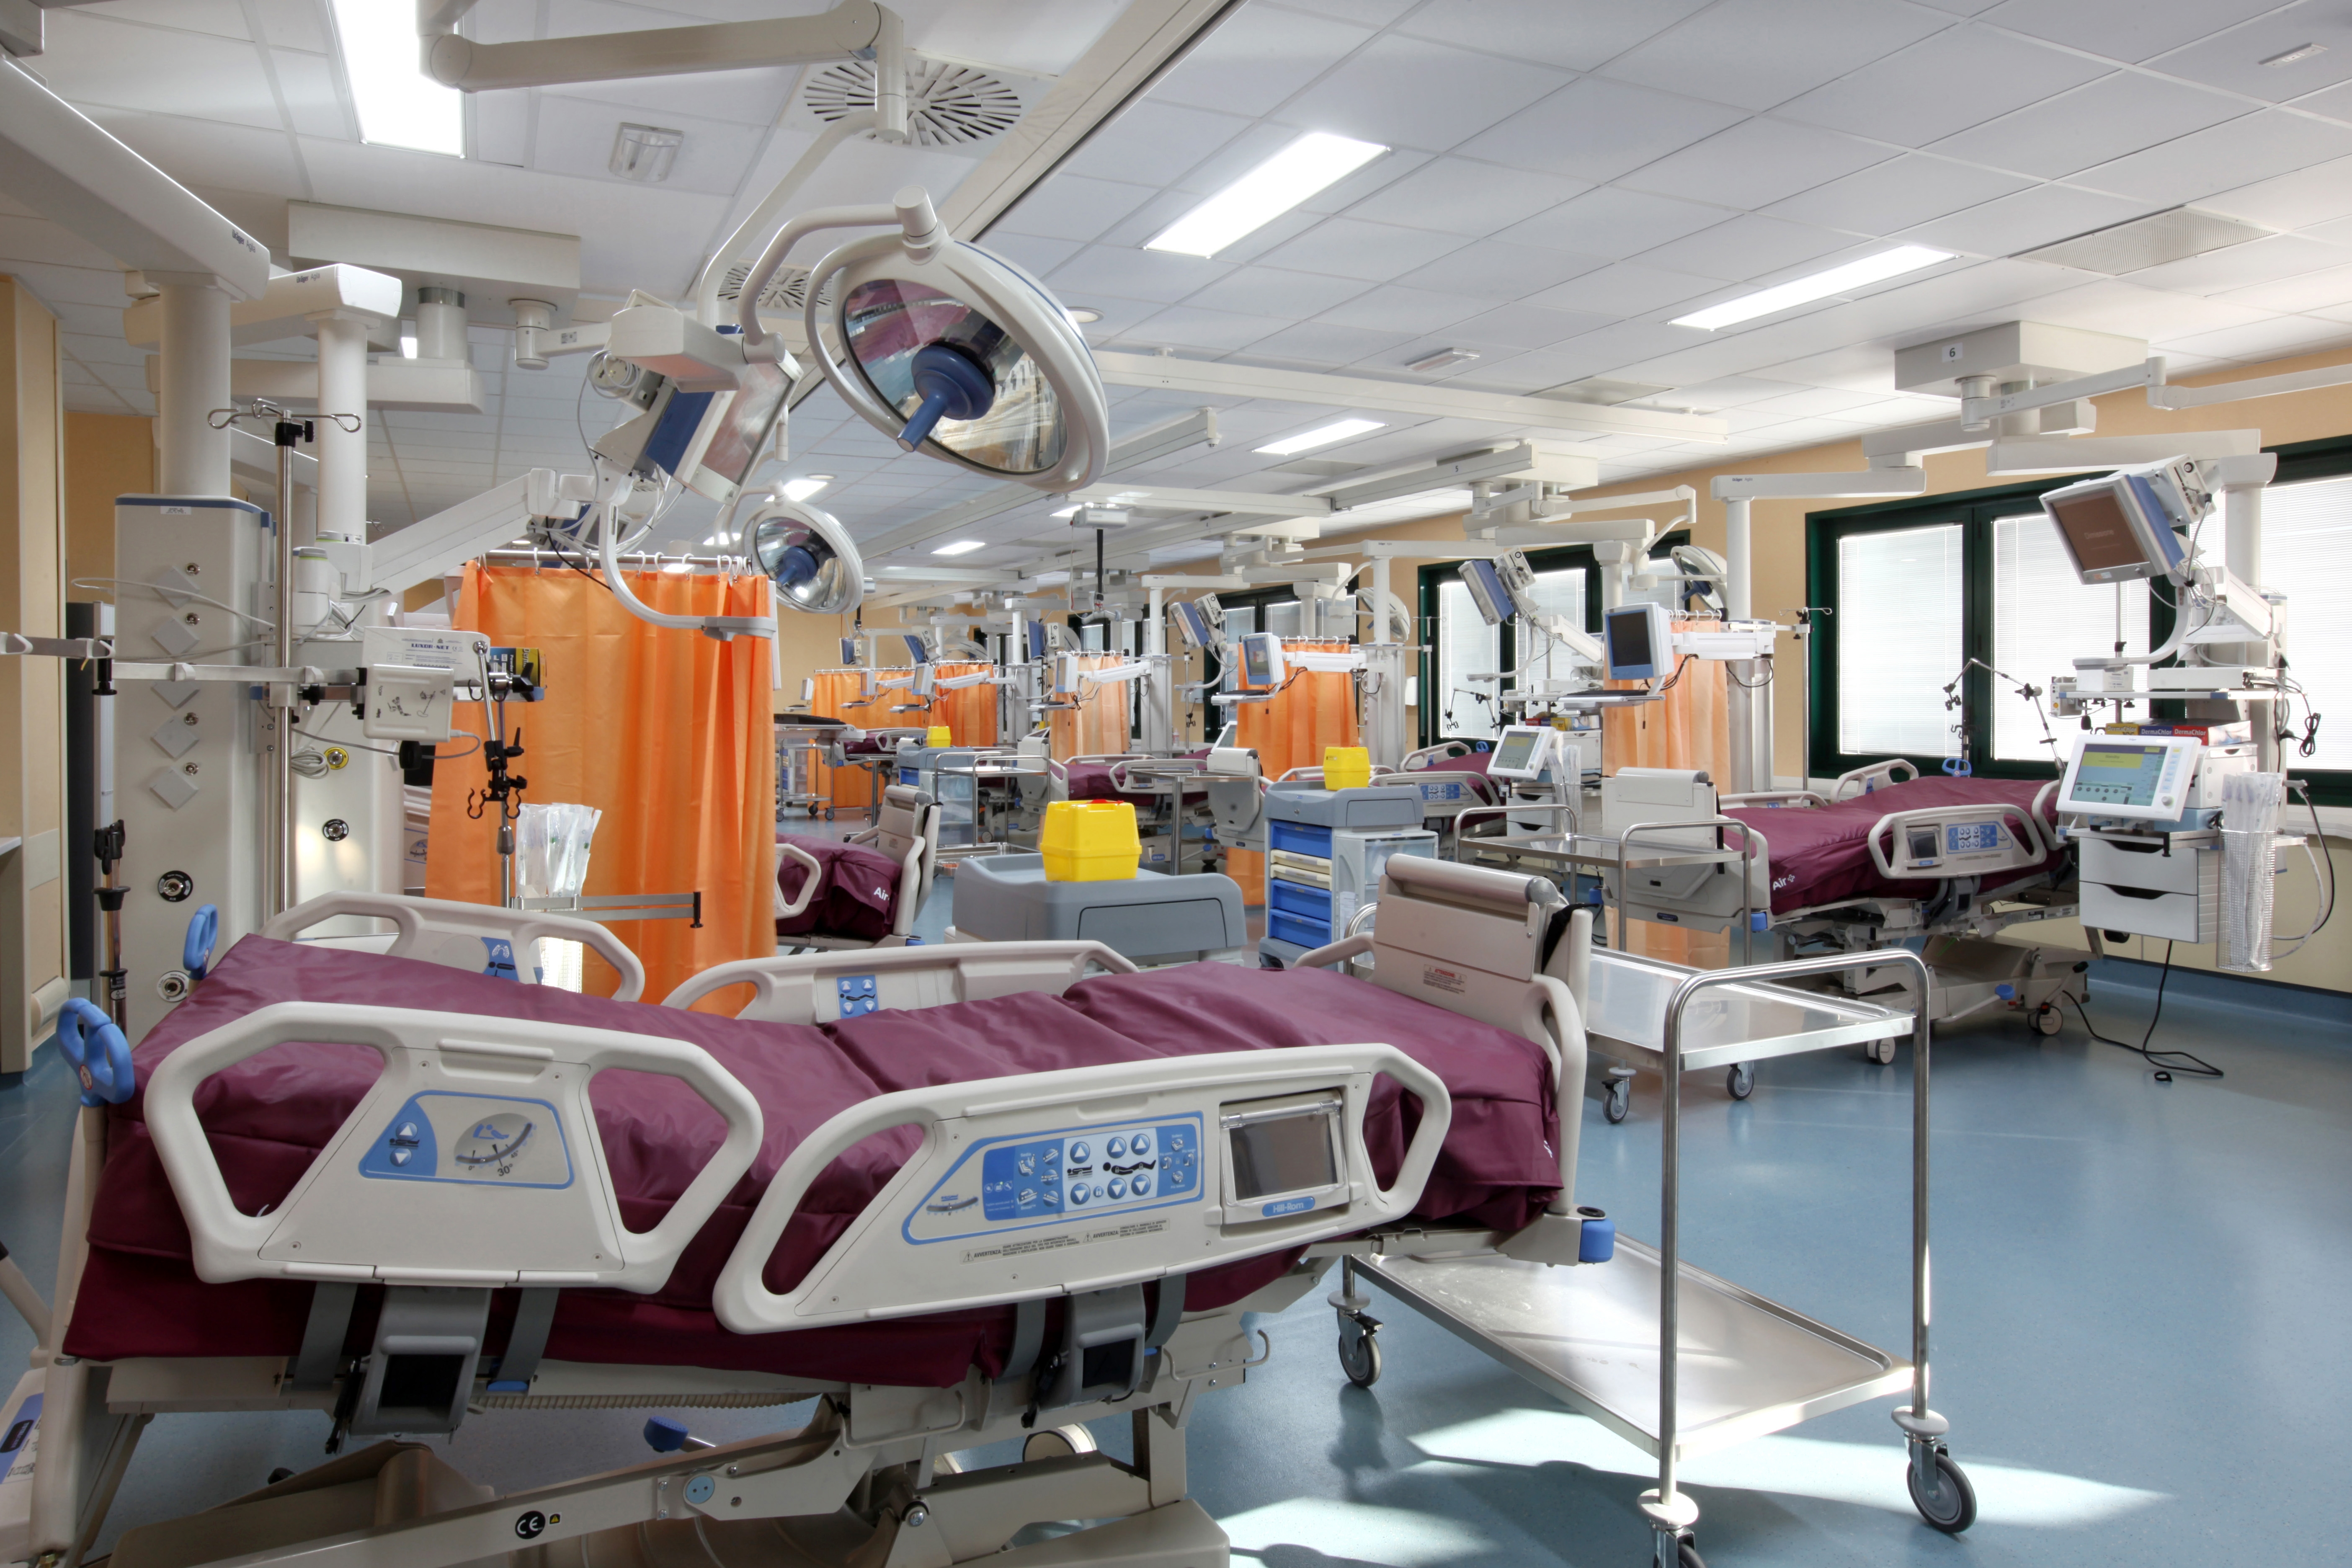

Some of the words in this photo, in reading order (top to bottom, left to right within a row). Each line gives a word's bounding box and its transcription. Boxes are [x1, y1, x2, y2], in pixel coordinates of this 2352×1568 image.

[1950, 348, 1955, 357] 6
[874, 887, 890, 901] Air
[1273, 1202, 1304, 1213] Hill-Rom
[1093, 1230, 1119, 1238] AVVERTENZA:
[974, 1249, 1002, 1258] AVVERTENZA:
